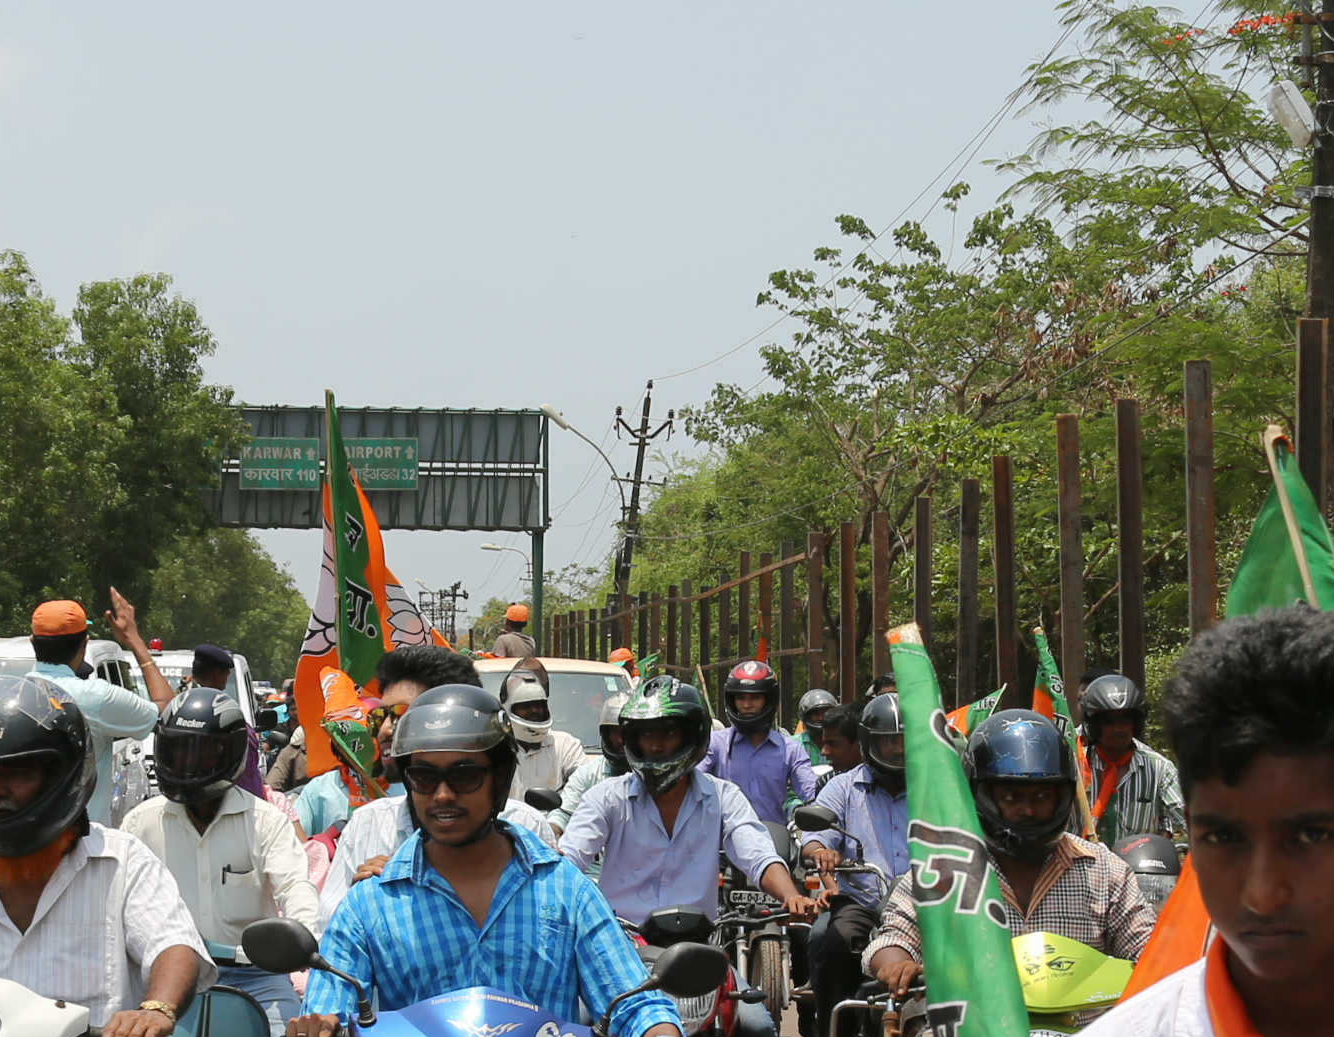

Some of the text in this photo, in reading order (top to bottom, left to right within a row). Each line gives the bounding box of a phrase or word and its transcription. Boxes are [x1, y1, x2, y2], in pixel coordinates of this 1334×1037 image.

[241, 447, 302, 460] KARWAR
[298, 469, 316, 481] 110
[402, 469, 416, 481] 32
